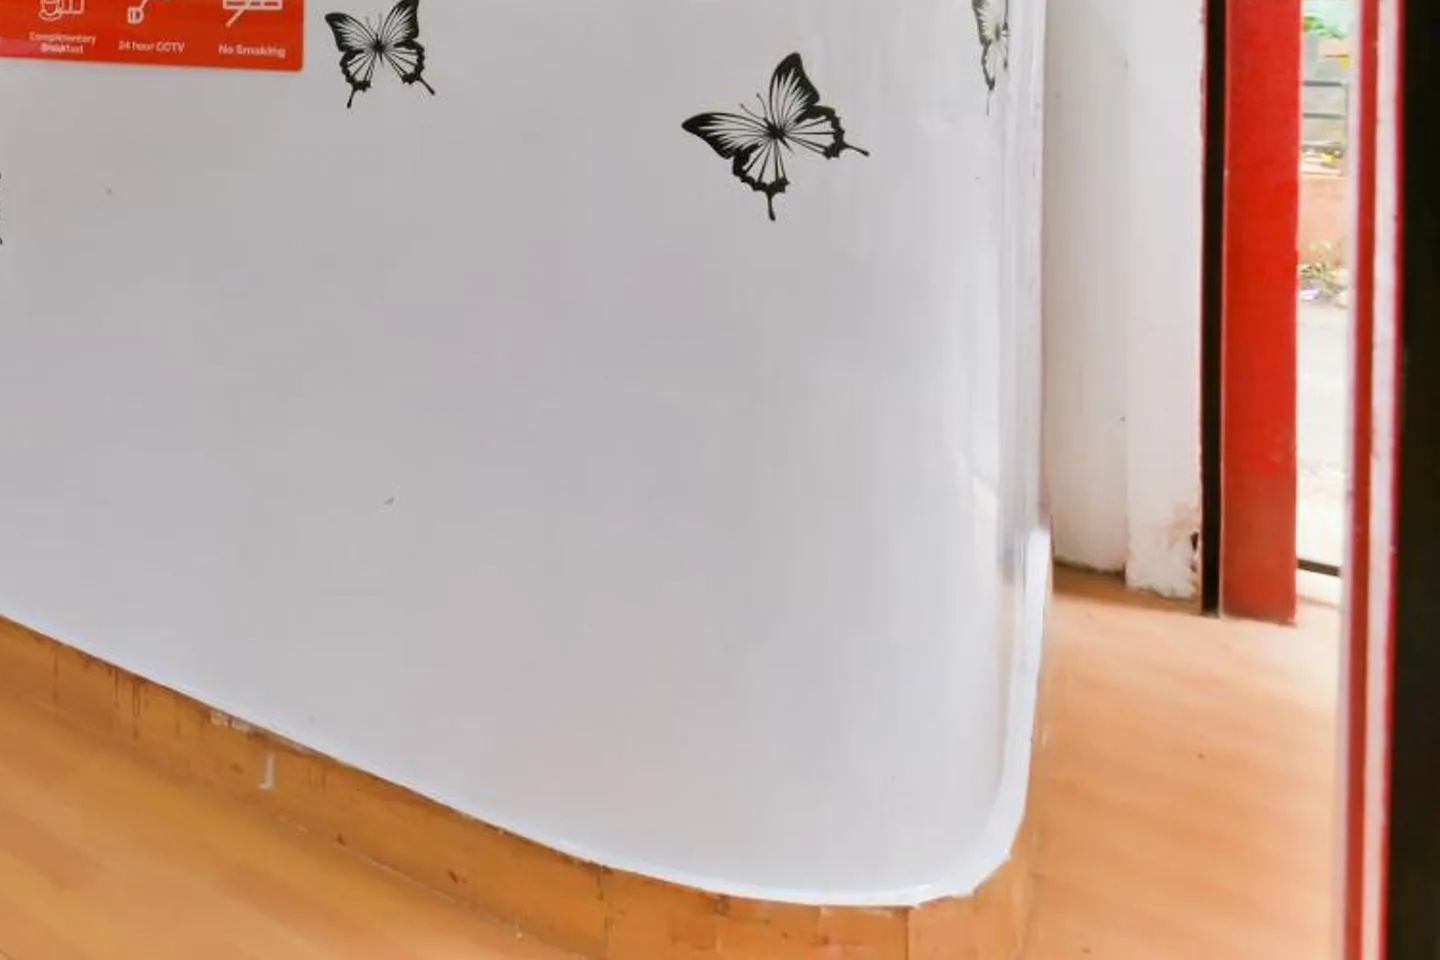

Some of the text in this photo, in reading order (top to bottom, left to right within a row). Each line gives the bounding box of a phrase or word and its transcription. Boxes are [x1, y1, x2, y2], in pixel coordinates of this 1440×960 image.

[155, 41, 185, 53] CCTV
[218, 44, 286, 58] No Smoking
